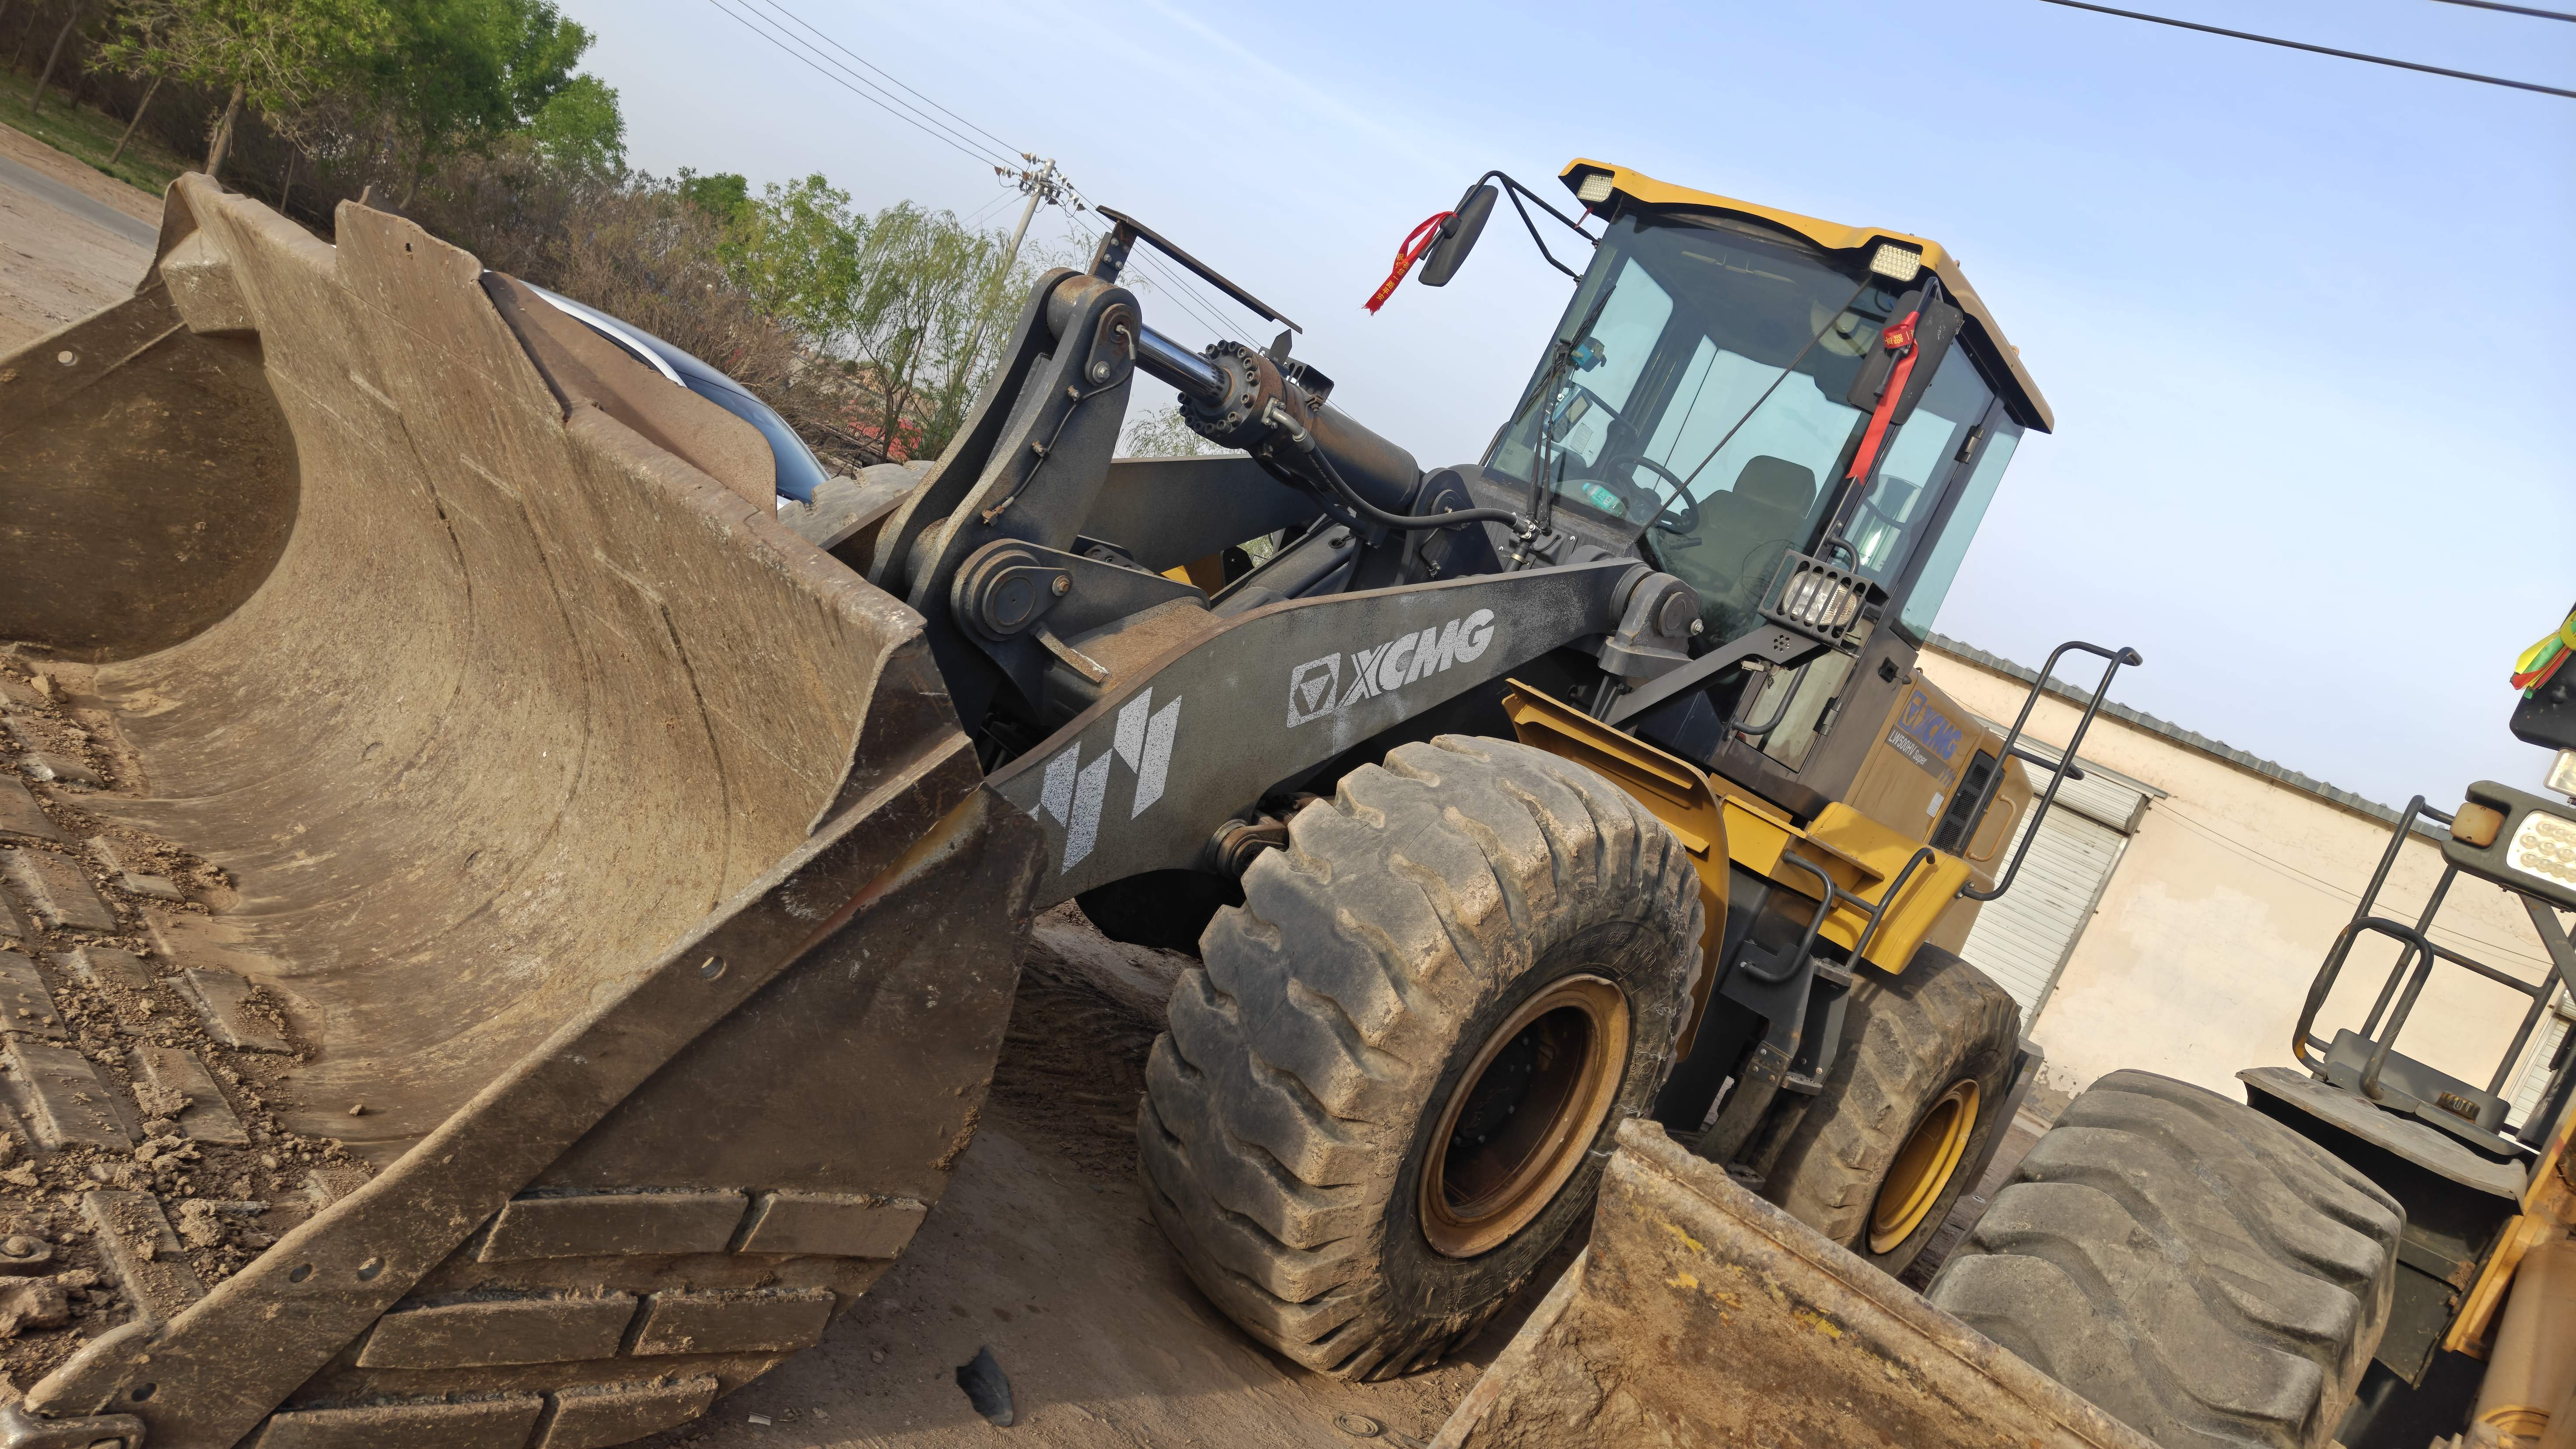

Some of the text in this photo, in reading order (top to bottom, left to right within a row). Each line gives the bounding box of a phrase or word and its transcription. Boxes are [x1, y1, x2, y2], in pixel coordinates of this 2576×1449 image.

[1336, 609, 1494, 710] XCMG
[1888, 730, 1928, 765] LW500HV Super
[1911, 704, 1962, 760] XCMG
